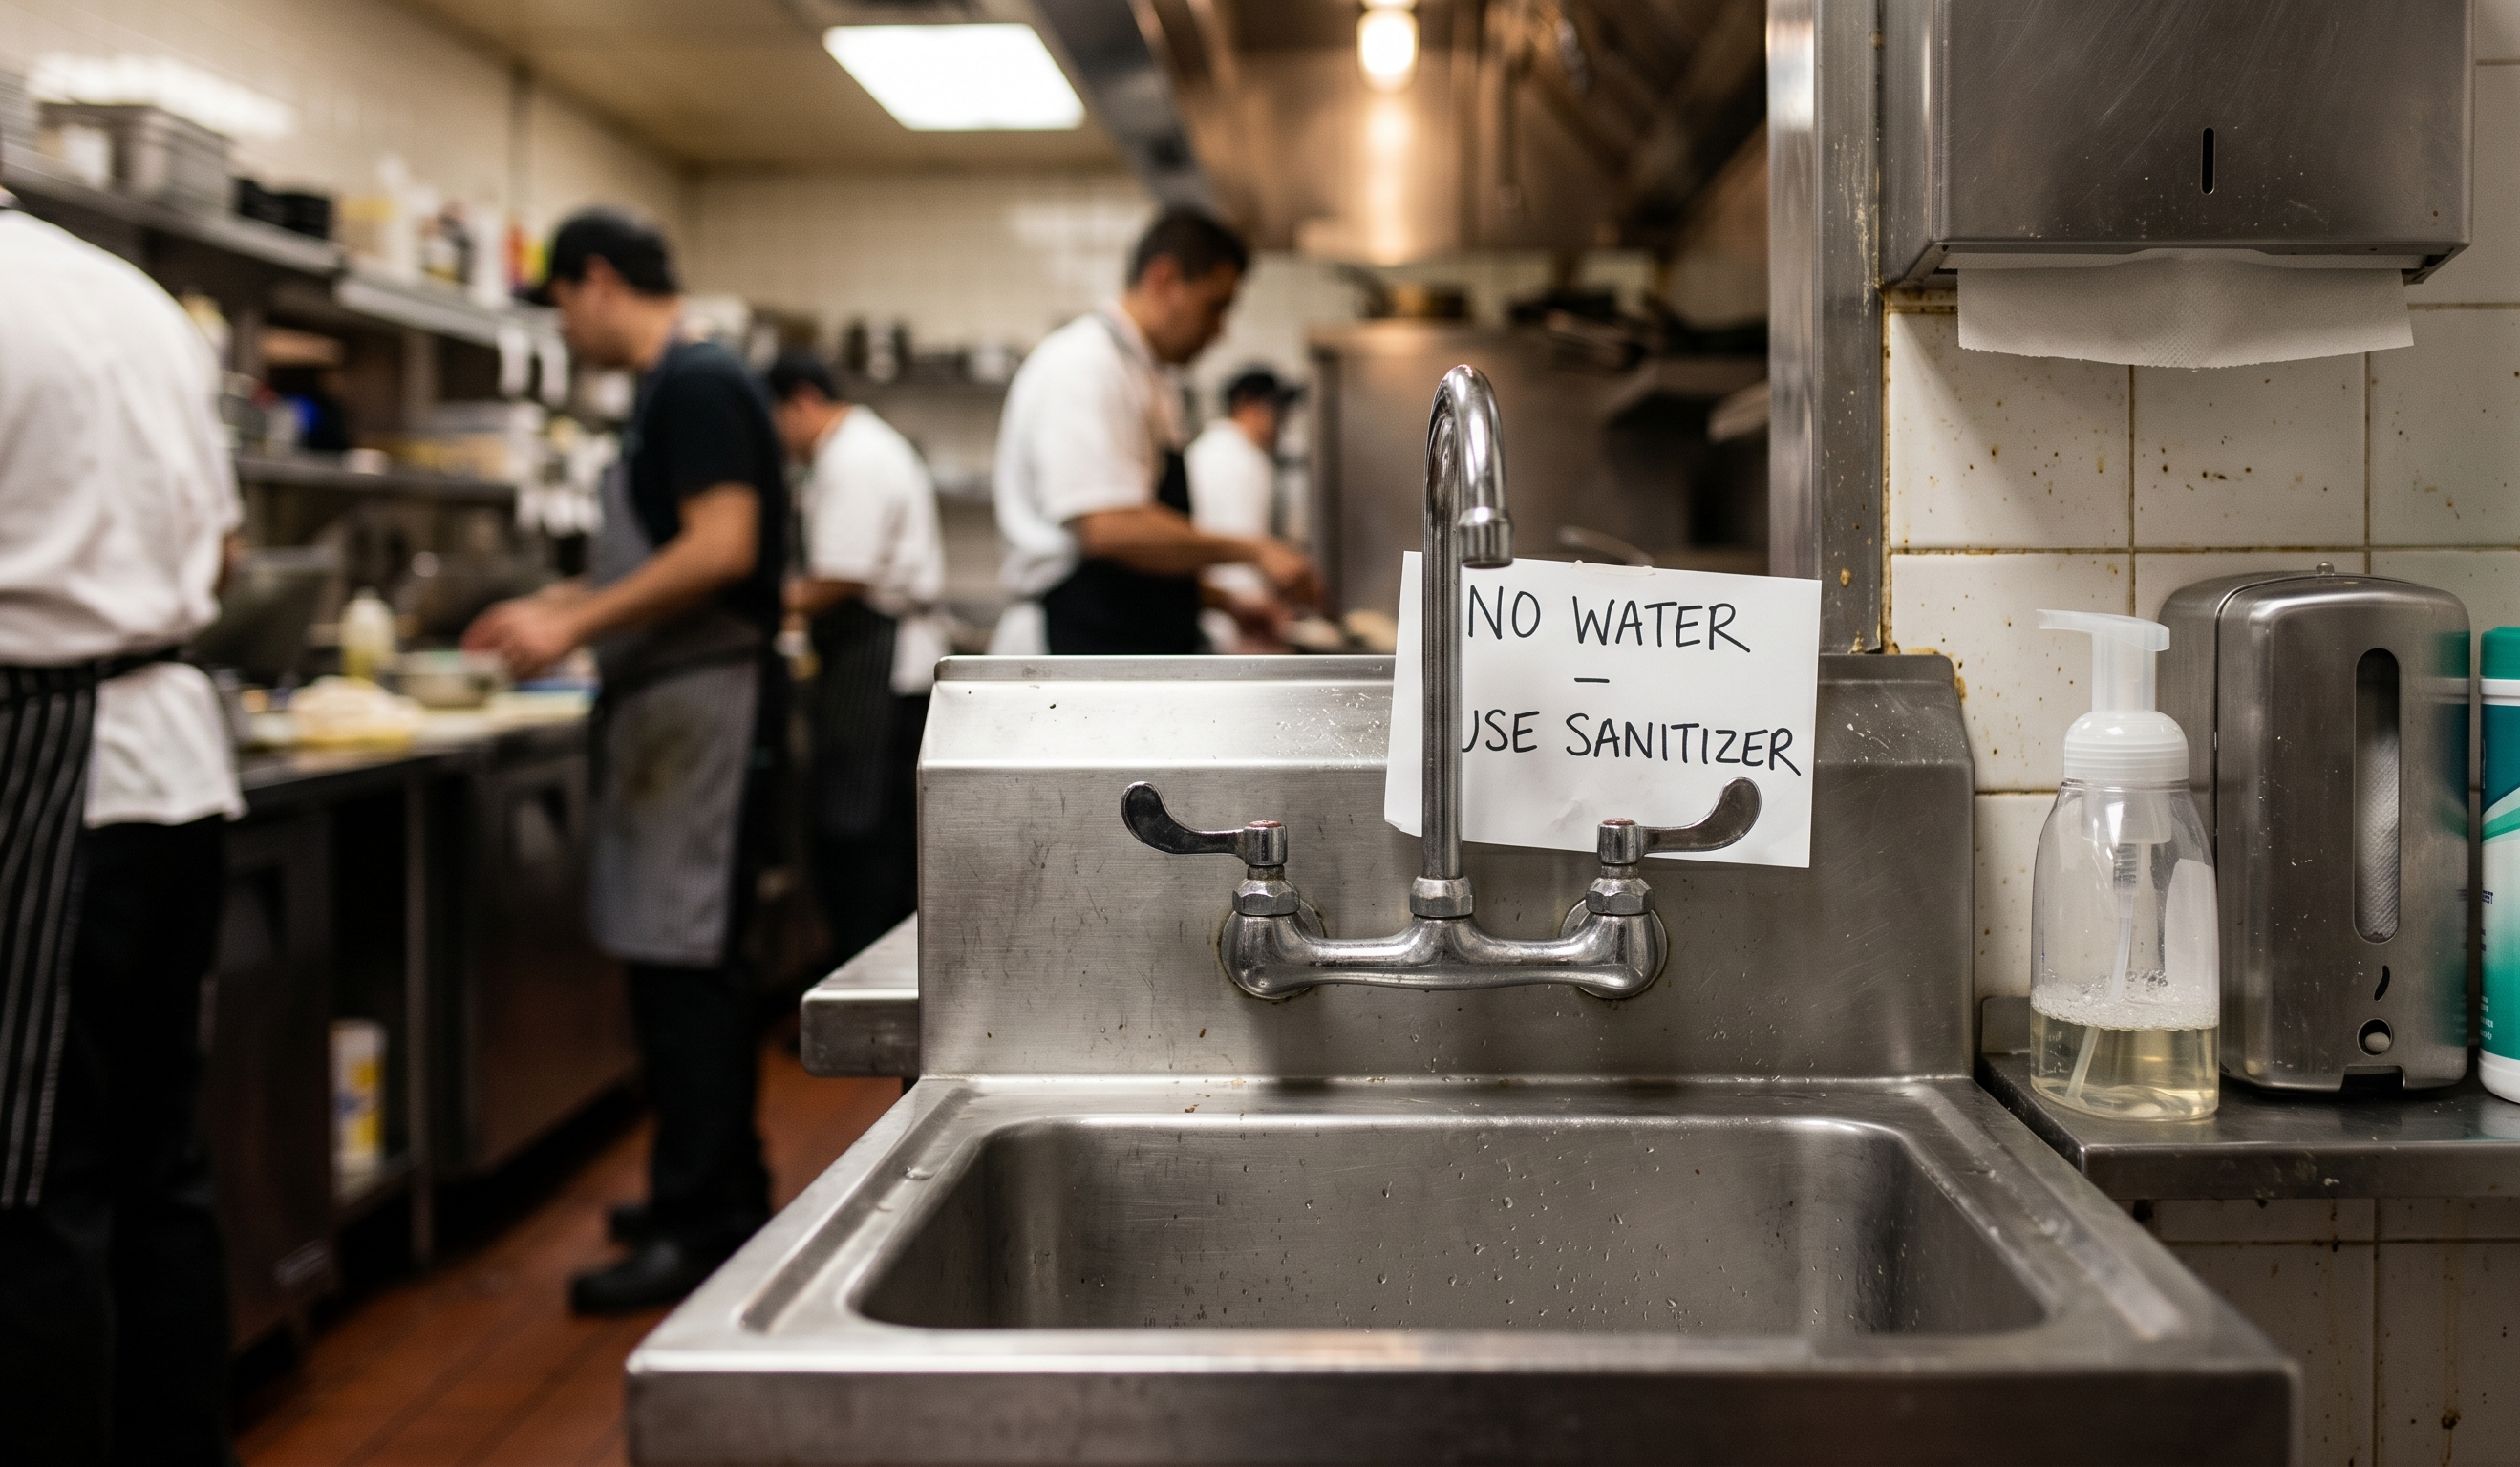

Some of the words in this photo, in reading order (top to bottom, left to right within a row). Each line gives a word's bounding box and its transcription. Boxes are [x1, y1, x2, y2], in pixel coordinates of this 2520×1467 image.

[1467, 585, 1541, 639] NO
[1572, 595, 1751, 653] WATER
[1565, 712, 1802, 776] SANITIZER
